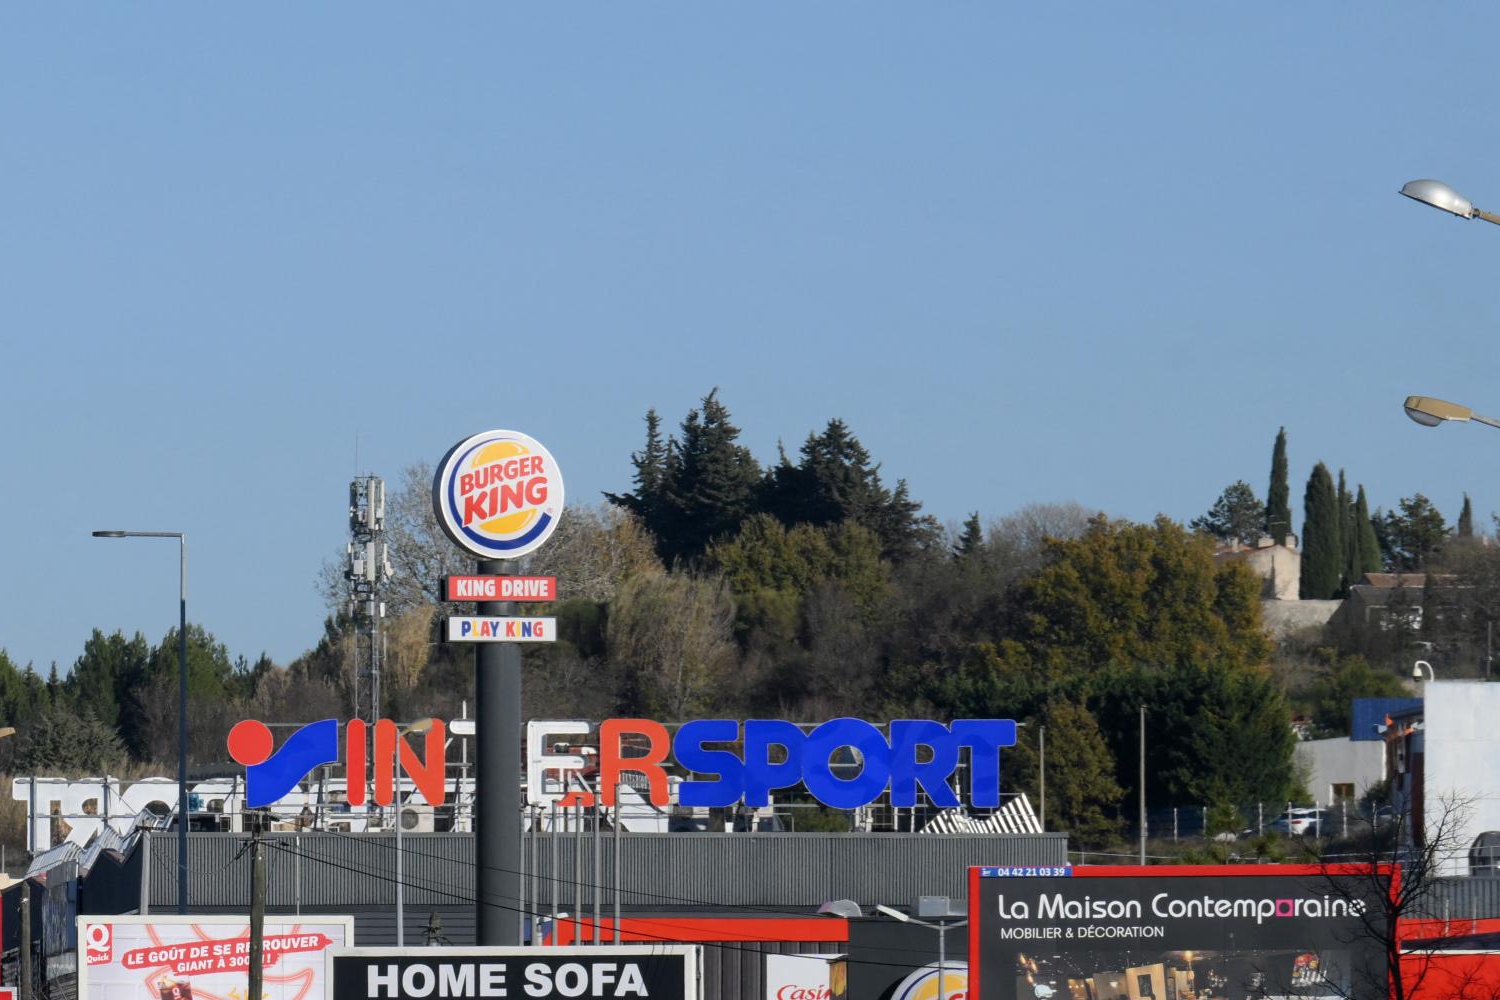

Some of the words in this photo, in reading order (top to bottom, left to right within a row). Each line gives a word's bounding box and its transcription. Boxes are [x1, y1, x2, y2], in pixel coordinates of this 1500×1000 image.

[460, 455, 544, 496] BURGER
[463, 476, 548, 527] KING
[457, 579, 496, 597] KING
[501, 579, 548, 597] DRIVE
[461, 620, 500, 637] PLAY
[505, 620, 544, 637] KING
[997, 868, 1010, 877] 04
[1012, 868, 1025, 877] 42
[1026, 868, 1038, 877] 21
[1040, 868, 1052, 877] 03
[1053, 868, 1066, 877] 39
[998, 894, 1029, 920] La
[1038, 893, 1141, 920] Maison
[1151, 893, 1367, 924] Contemporaine
[1001, 927, 1063, 940] MOBILIER
[1065, 927, 1074, 939] &
[1078, 924, 1165, 939] DÉCORATION
[86, 953, 109, 964] Quick
[127, 953, 144, 966] LE
[148, 948, 186, 963] GOÛT
[190, 947, 208, 958] DE
[213, 945, 231, 956] SE
[177, 960, 213, 974] GIANT
[217, 956, 227, 969] À
[367, 963, 508, 998] HOME
[523, 962, 649, 998] SOFA
